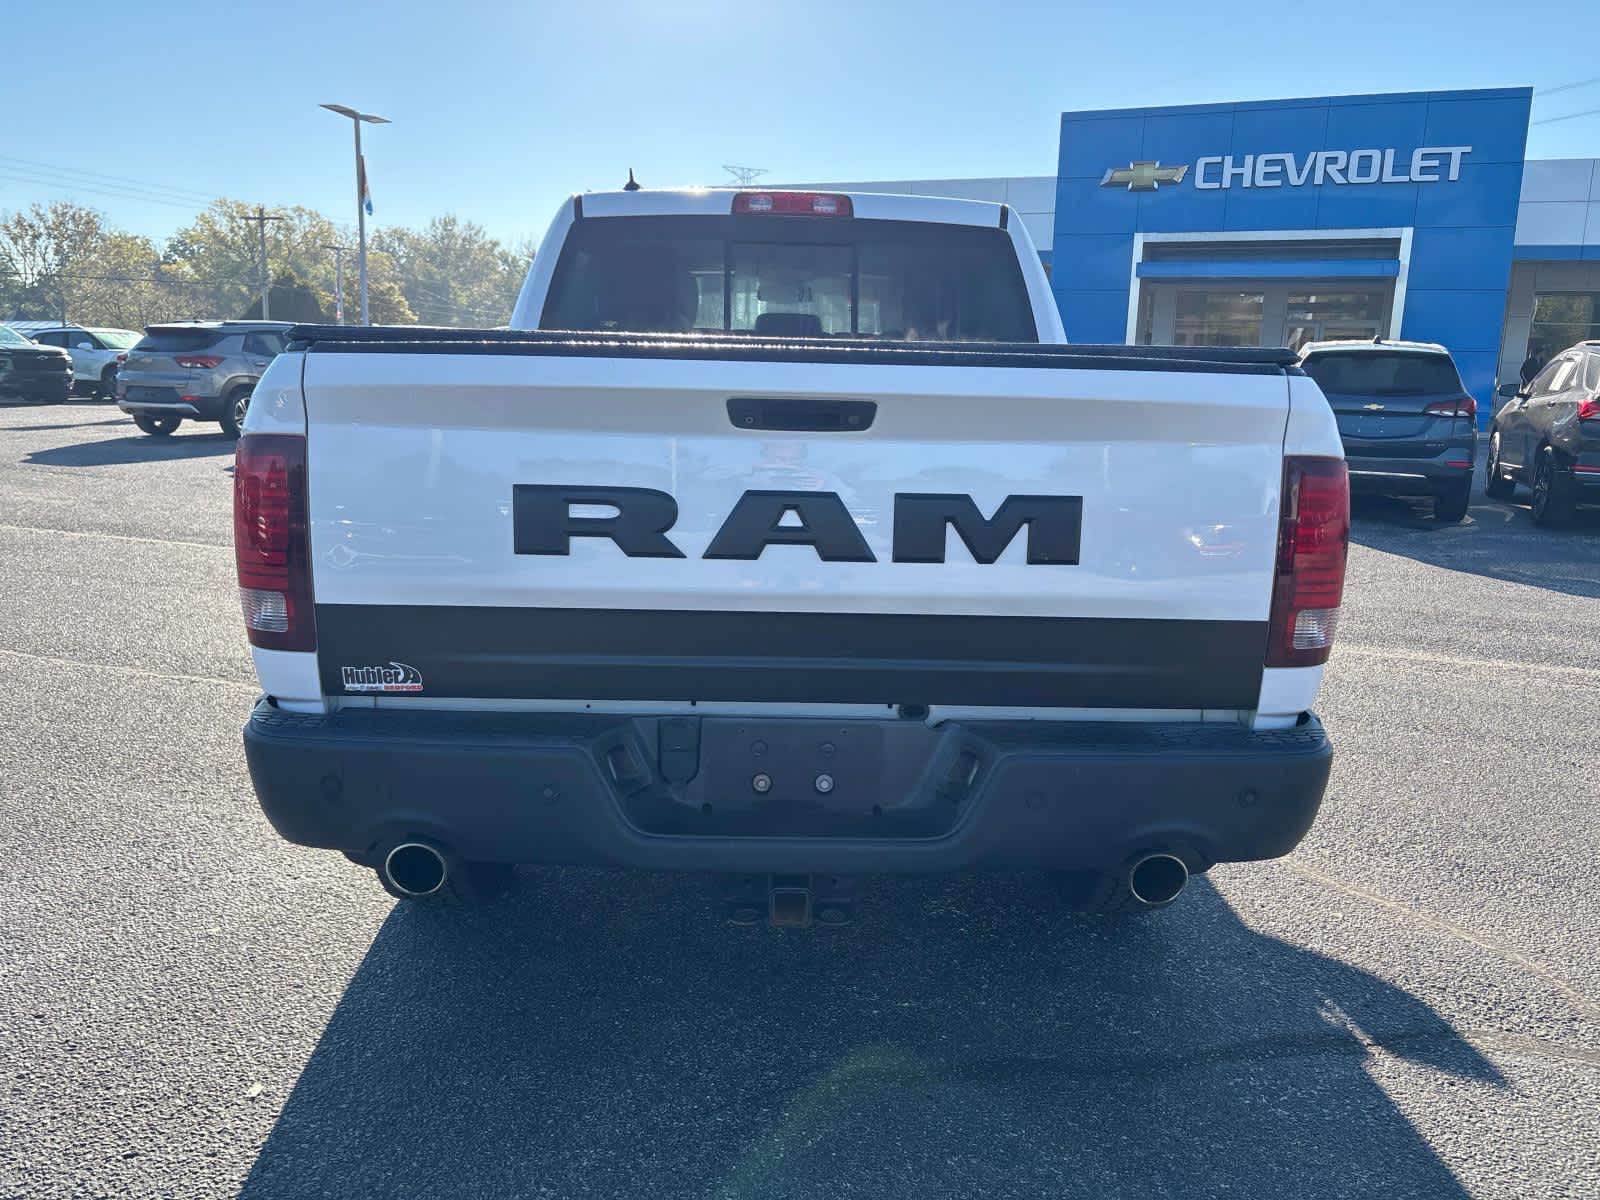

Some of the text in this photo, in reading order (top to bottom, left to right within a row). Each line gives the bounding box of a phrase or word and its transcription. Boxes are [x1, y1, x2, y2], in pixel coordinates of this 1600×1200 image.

[1194, 145, 1473, 190] CHEVROLET
[513, 484, 1083, 565] RAM
[342, 667, 402, 685] Hubler
